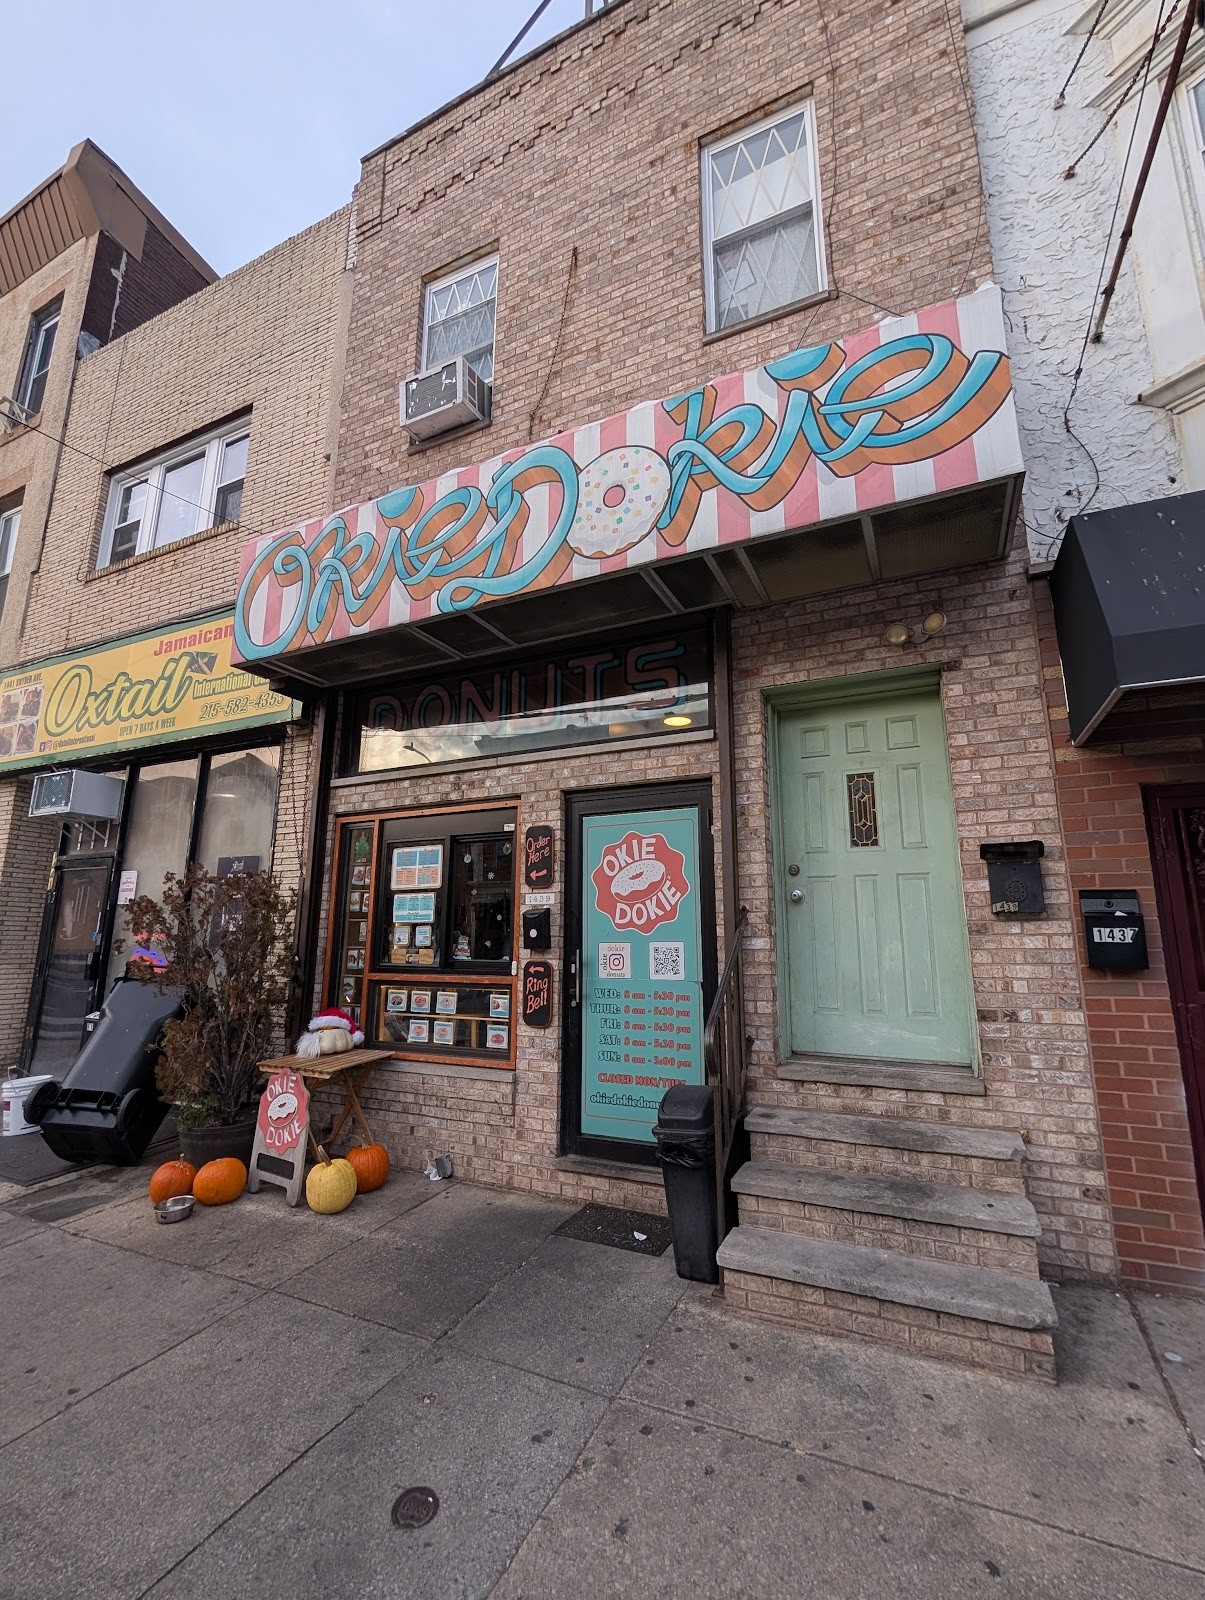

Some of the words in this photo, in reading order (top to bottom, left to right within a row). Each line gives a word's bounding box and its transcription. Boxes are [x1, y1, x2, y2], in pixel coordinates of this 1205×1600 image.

[153, 624, 234, 657] Jamaican
[44, 651, 193, 737] Oxtail
[193, 672, 252, 700] International
[368, 640, 687, 743] DONUTS
[119, 725, 133, 737] OPEN
[134, 724, 139, 734] 7
[139, 721, 155, 734] DAYS
[154, 720, 159, 730] A
[160, 717, 177, 728] WEEK
[526, 835, 551, 853] Order
[527, 846, 551, 867] Here
[602, 837, 656, 877] OKIE
[528, 894, 551, 903] 1439
[614, 880, 682, 926] DOKIE
[1095, 927, 1139, 942] 1437
[526, 976, 549, 995] Ring
[594, 987, 621, 1000] WED:
[631, 991, 646, 1000] am
[676, 993, 691, 1003] pm
[526, 990, 548, 1014] Bell
[590, 1003, 621, 1015] THUR:
[631, 1007, 646, 1015] am
[676, 1009, 691, 1018] pm
[600, 1018, 621, 1029] FRI:
[676, 1024, 691, 1034] pm
[599, 1034, 621, 1046] SAT:
[631, 1039, 646, 1047] am
[676, 1042, 692, 1051] pm
[598, 1051, 621, 1062] SUN:
[631, 1056, 646, 1064] am
[677, 1060, 692, 1069] pm
[266, 1075, 297, 1102] OKIE
[598, 1072, 634, 1085] CLOSED
[265, 1116, 303, 1146] DOKIE
